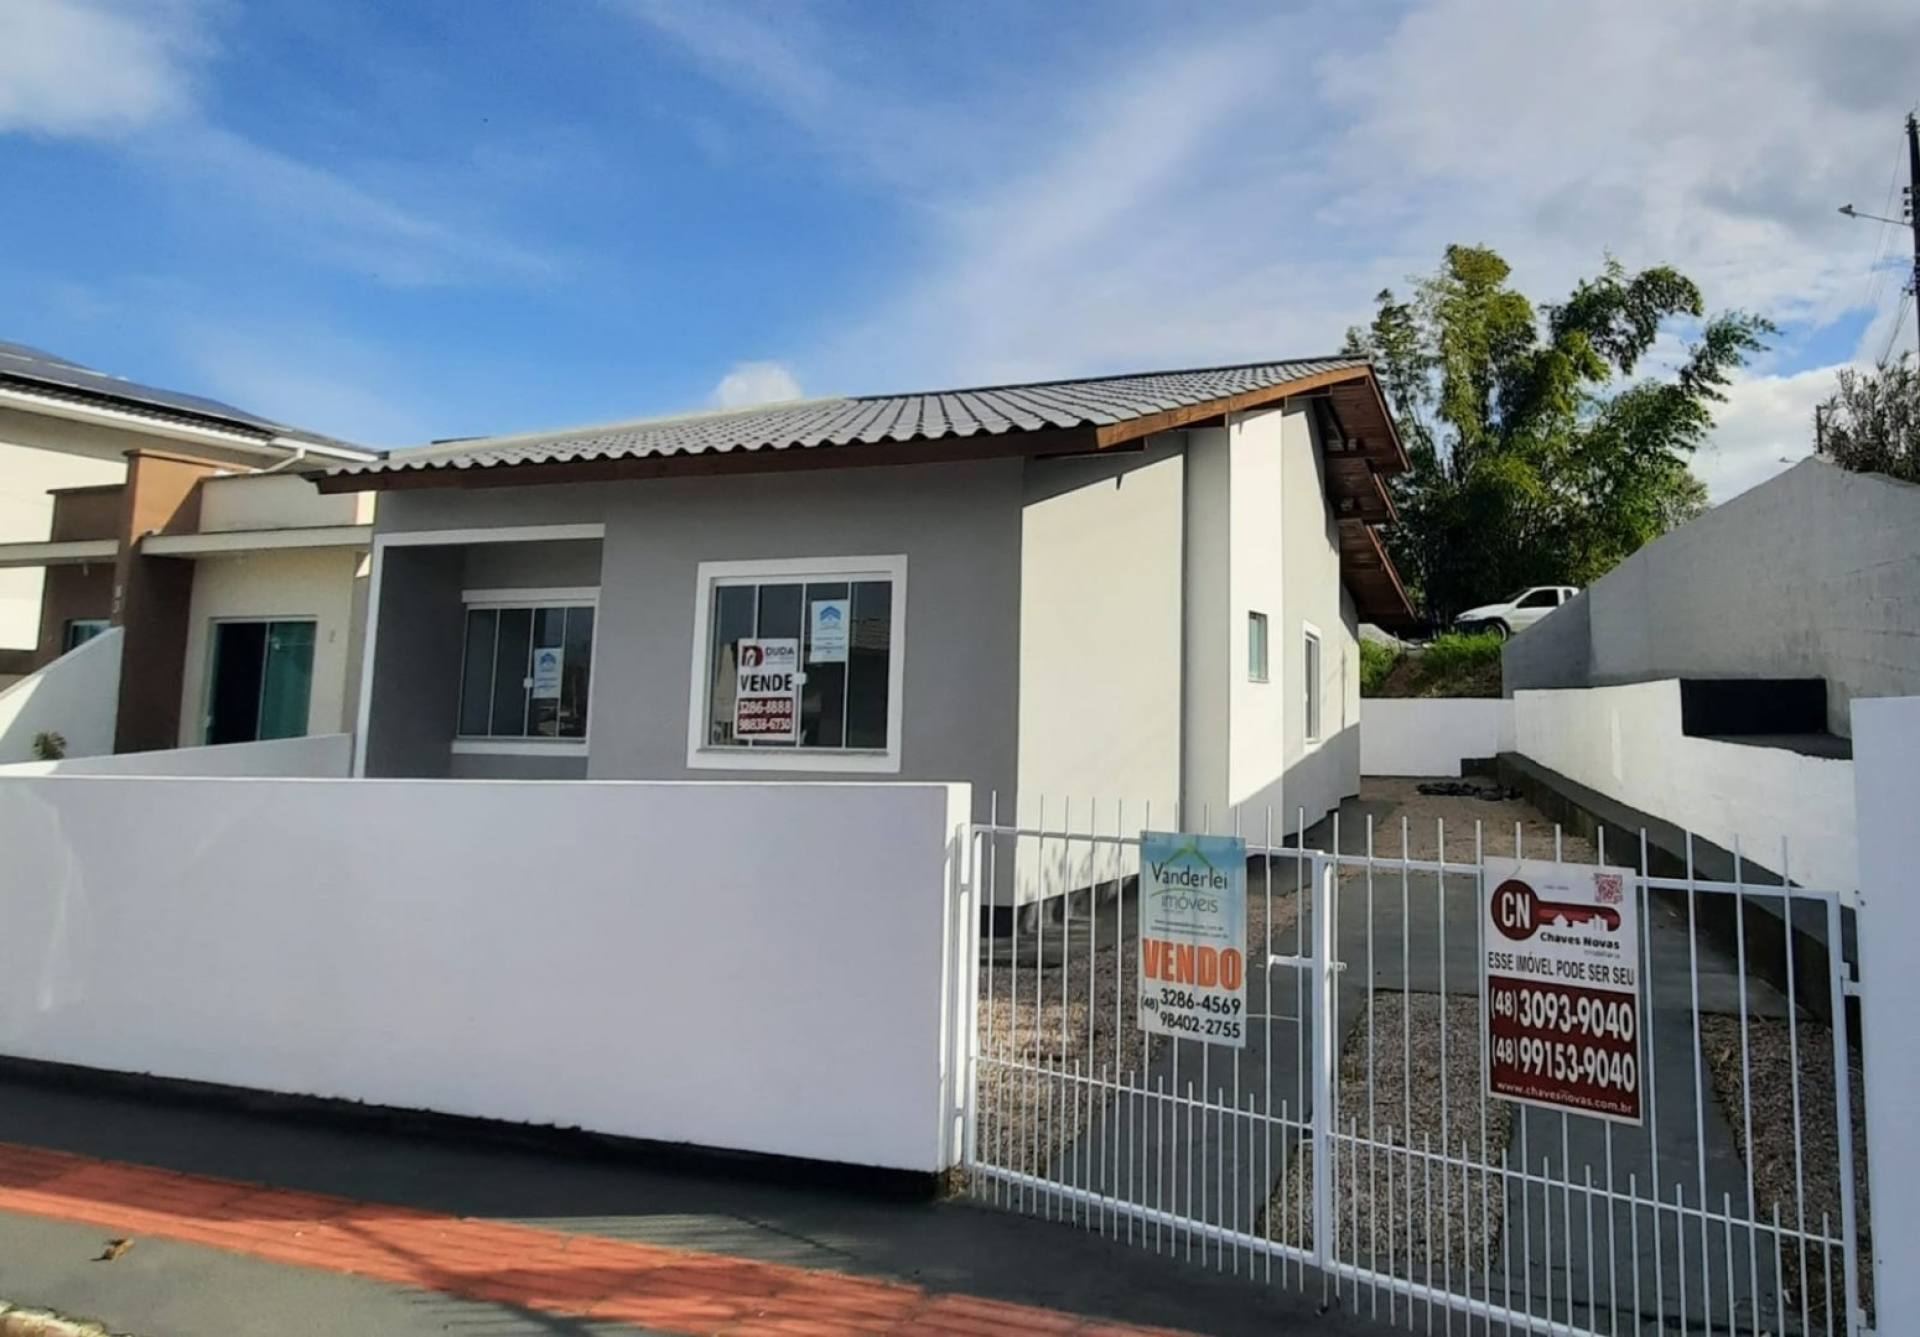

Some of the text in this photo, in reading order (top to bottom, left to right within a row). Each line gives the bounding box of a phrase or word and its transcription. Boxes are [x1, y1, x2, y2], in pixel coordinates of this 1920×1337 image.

[740, 673, 793, 691] VENDE
[1151, 861, 1228, 889] Vanderlei
[1161, 892, 1218, 913] imóveis
[1501, 891, 1531, 929] CN
[1540, 932, 1620, 950] Chaves Novas
[1142, 938, 1242, 990] VENDO
[1488, 951, 1635, 986] ESSE IMÓVEL PODE SER SEU
[1140, 988, 1242, 1017] (48) 3286-4569
[1491, 987, 1634, 1042] (48) 3093-9040
[1160, 1011, 1241, 1038] 98402-2755
[1491, 1035, 1636, 1093] (48) 99153-9040
[1497, 1082, 1633, 1113] www.chavesnovas.com.br
